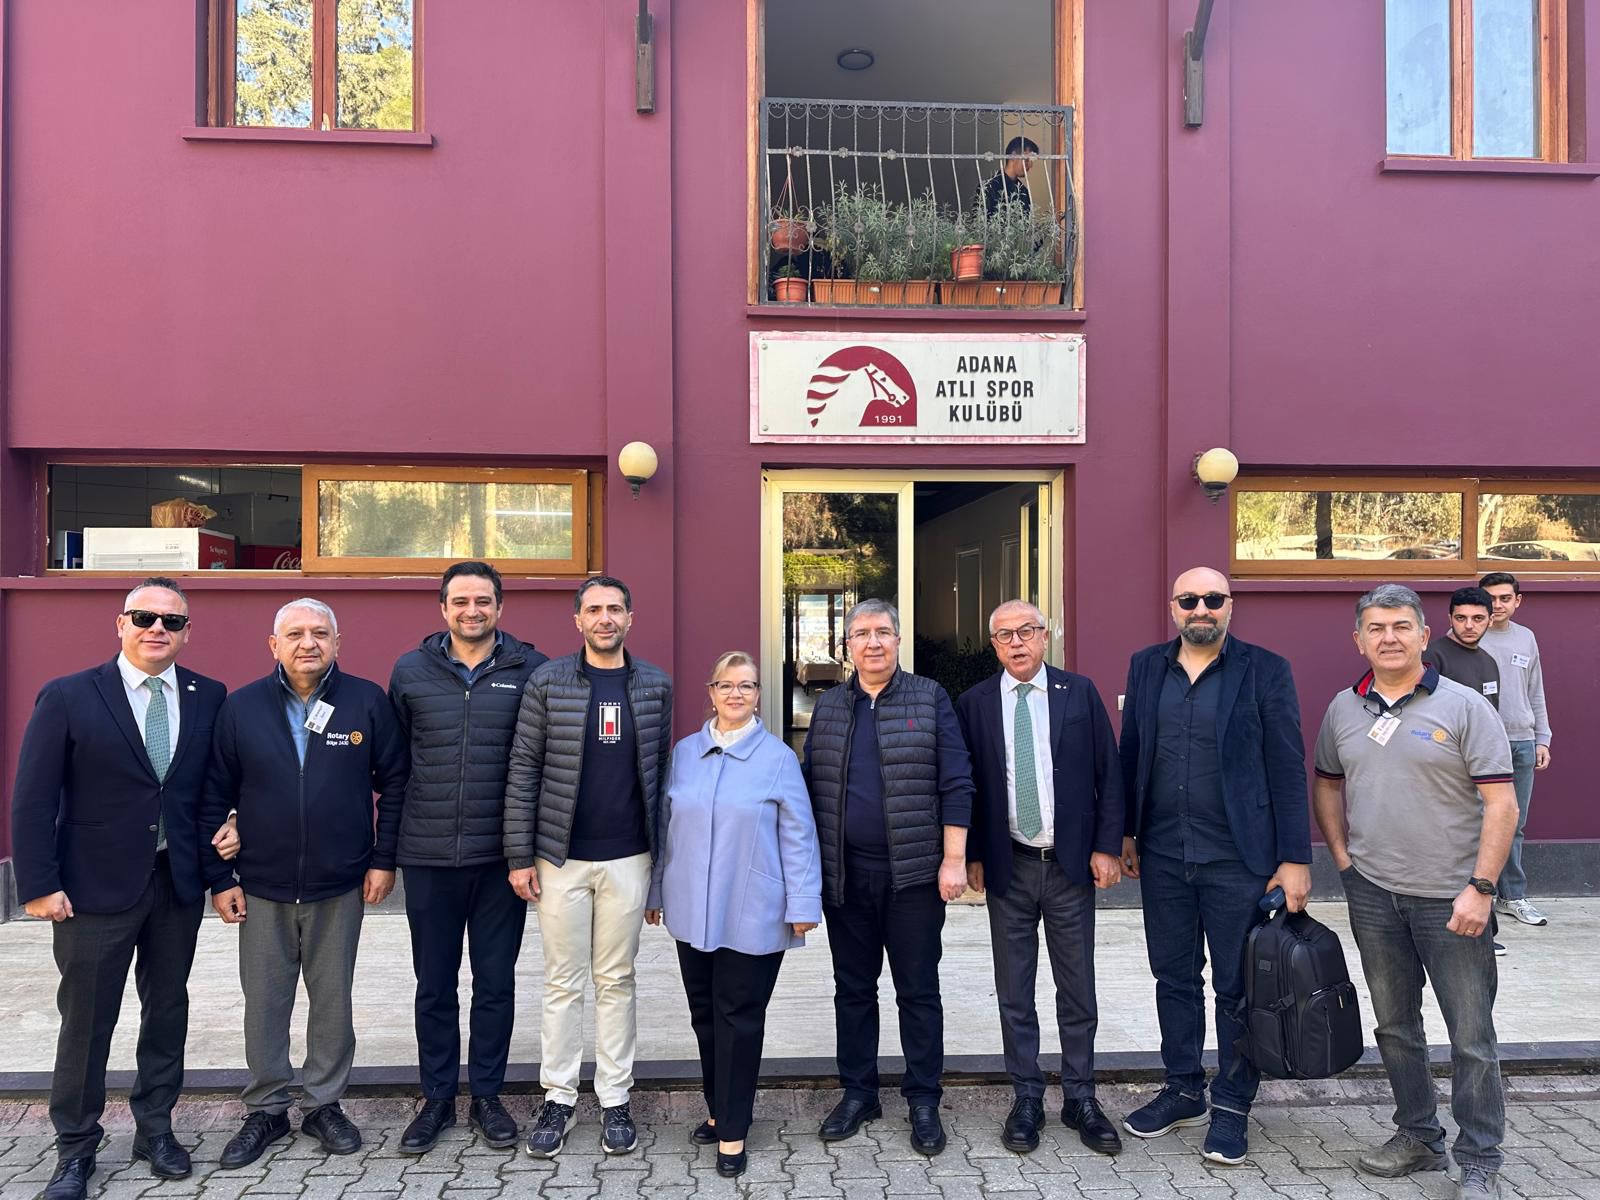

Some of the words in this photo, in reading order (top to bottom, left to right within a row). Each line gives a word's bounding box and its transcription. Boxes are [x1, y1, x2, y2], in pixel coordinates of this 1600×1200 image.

[956, 355, 1018, 373] ADANA
[935, 380, 975, 398] ATLI
[986, 380, 1034, 399] SPOR
[874, 415, 903, 424] 1991
[949, 401, 1022, 422] KULÜBÜ
